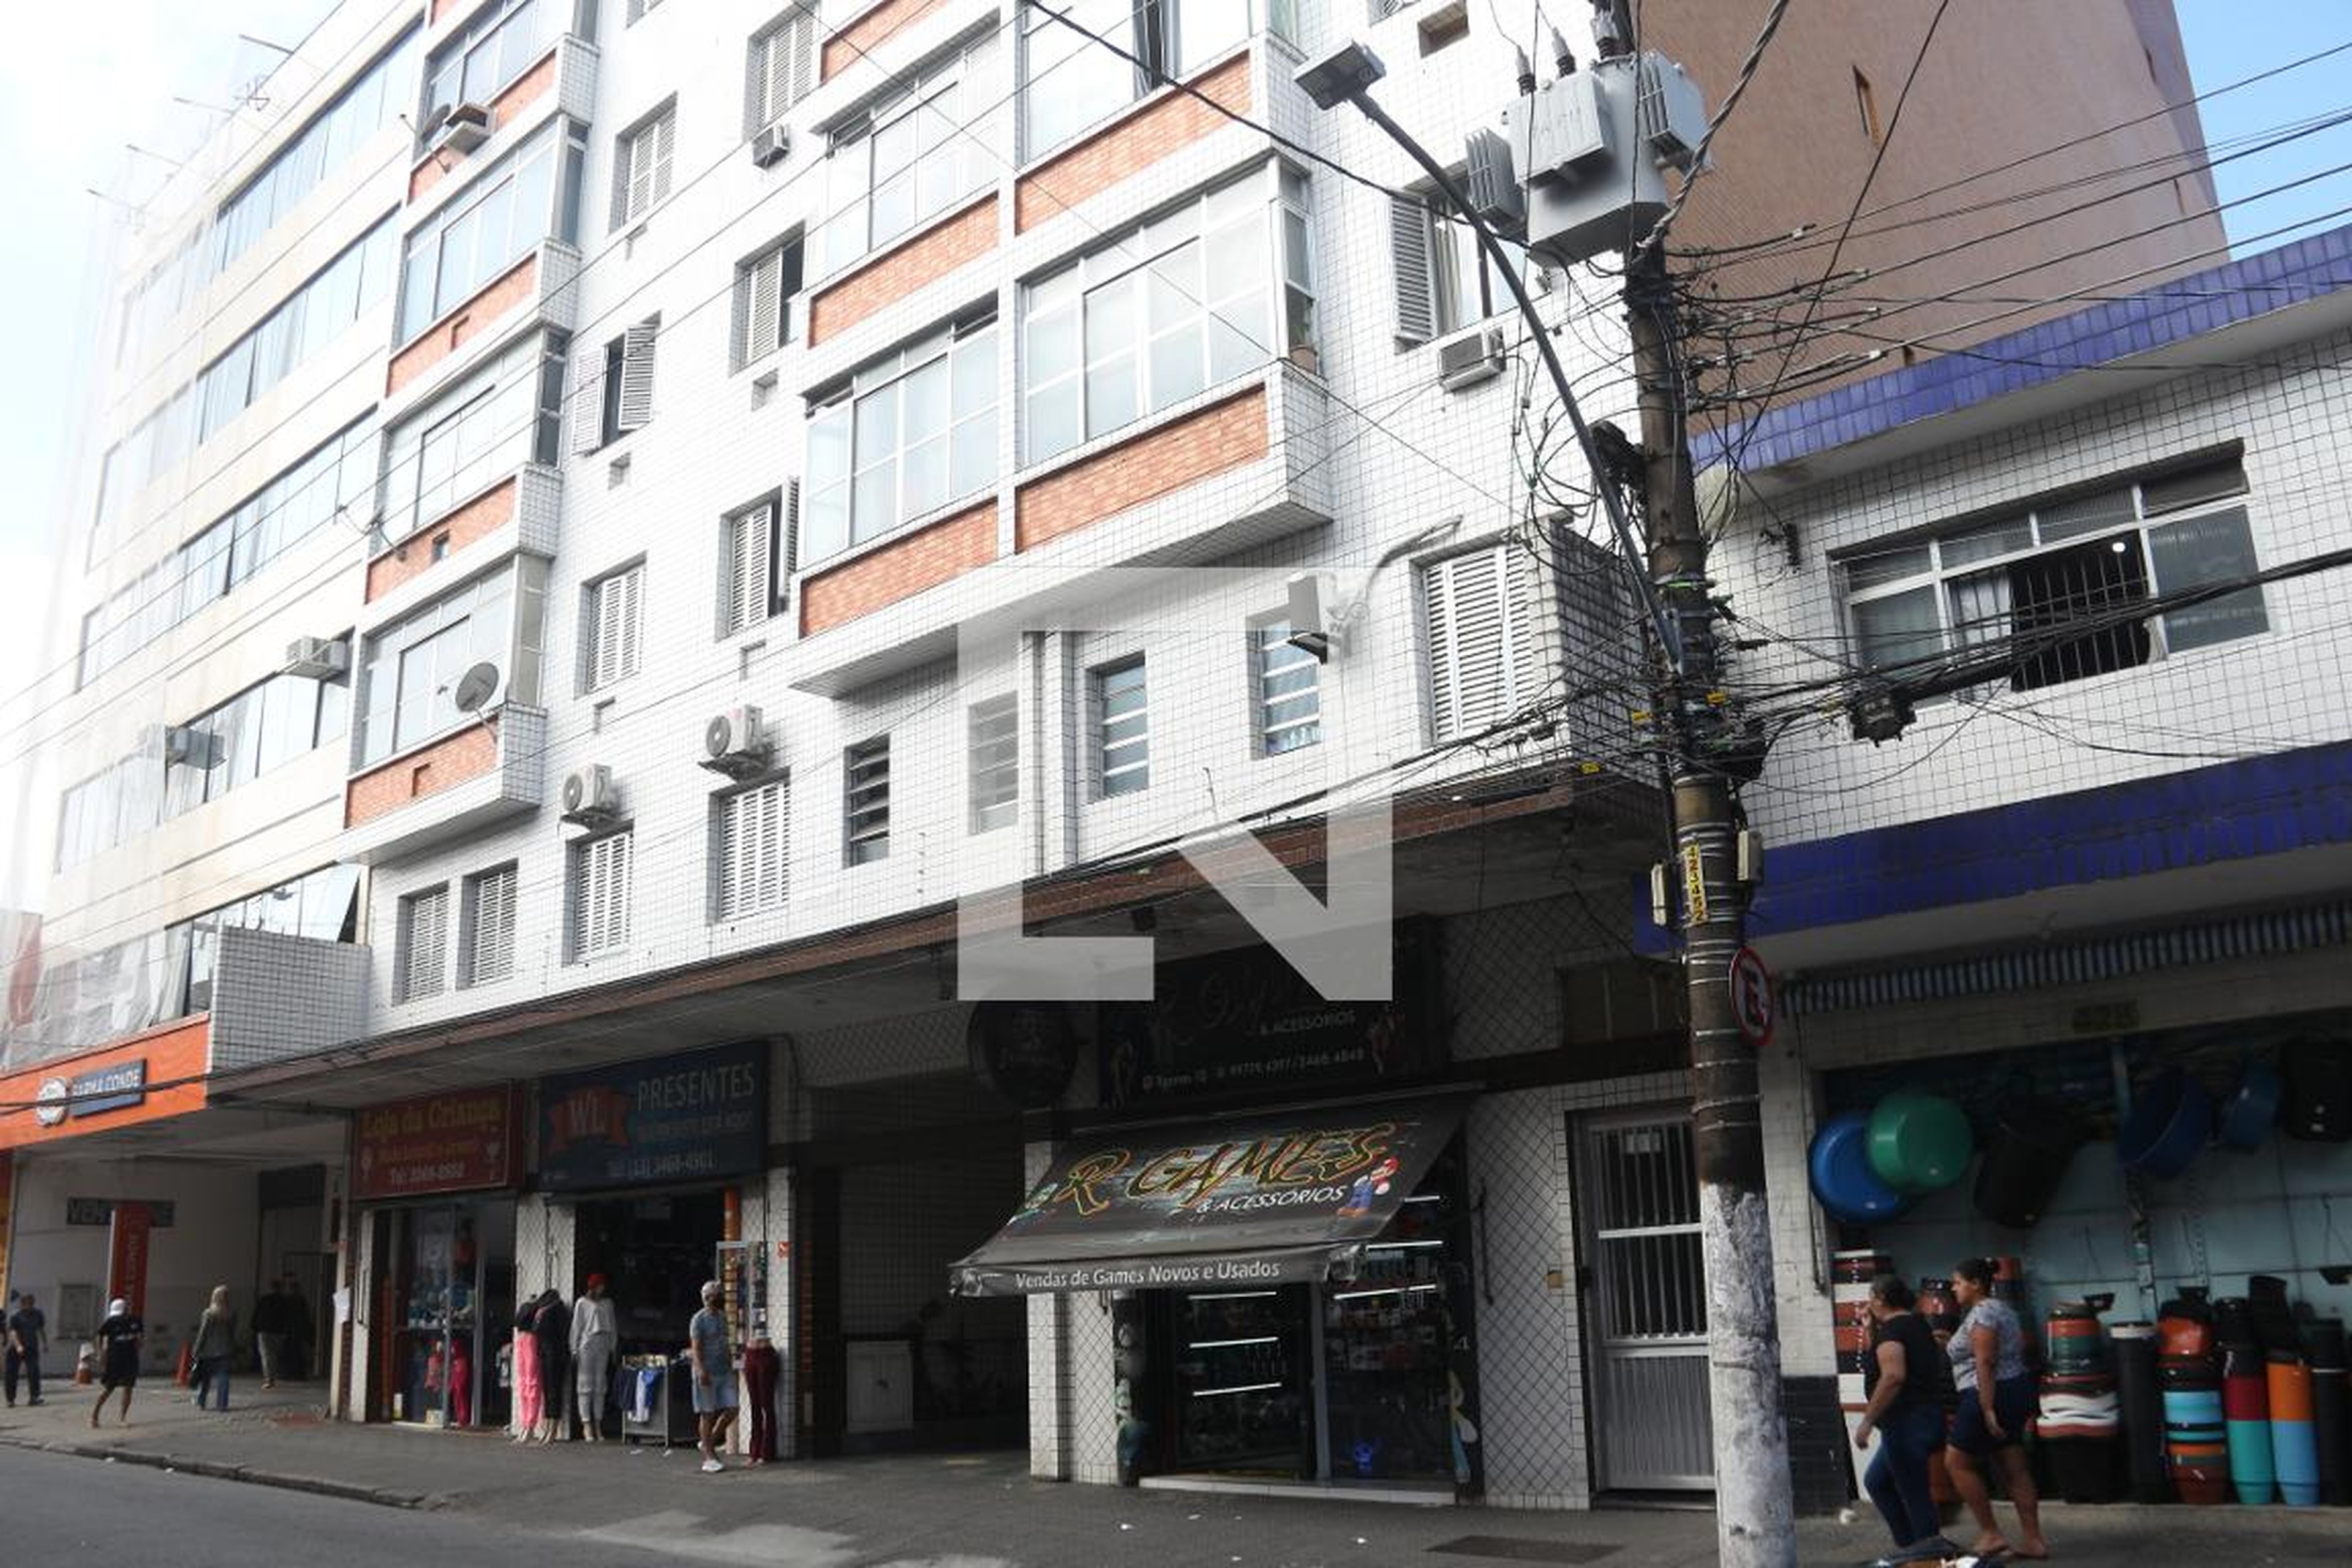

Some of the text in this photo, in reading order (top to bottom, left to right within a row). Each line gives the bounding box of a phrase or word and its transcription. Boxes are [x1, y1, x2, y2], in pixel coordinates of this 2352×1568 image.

[638, 1061, 755, 1112] PRESENTES
[1054, 1122, 1396, 1215] R GAMES
[1196, 1198, 1212, 1213] &
[1015, 1261, 1281, 1287] Vendas de Games Novos e Usados
